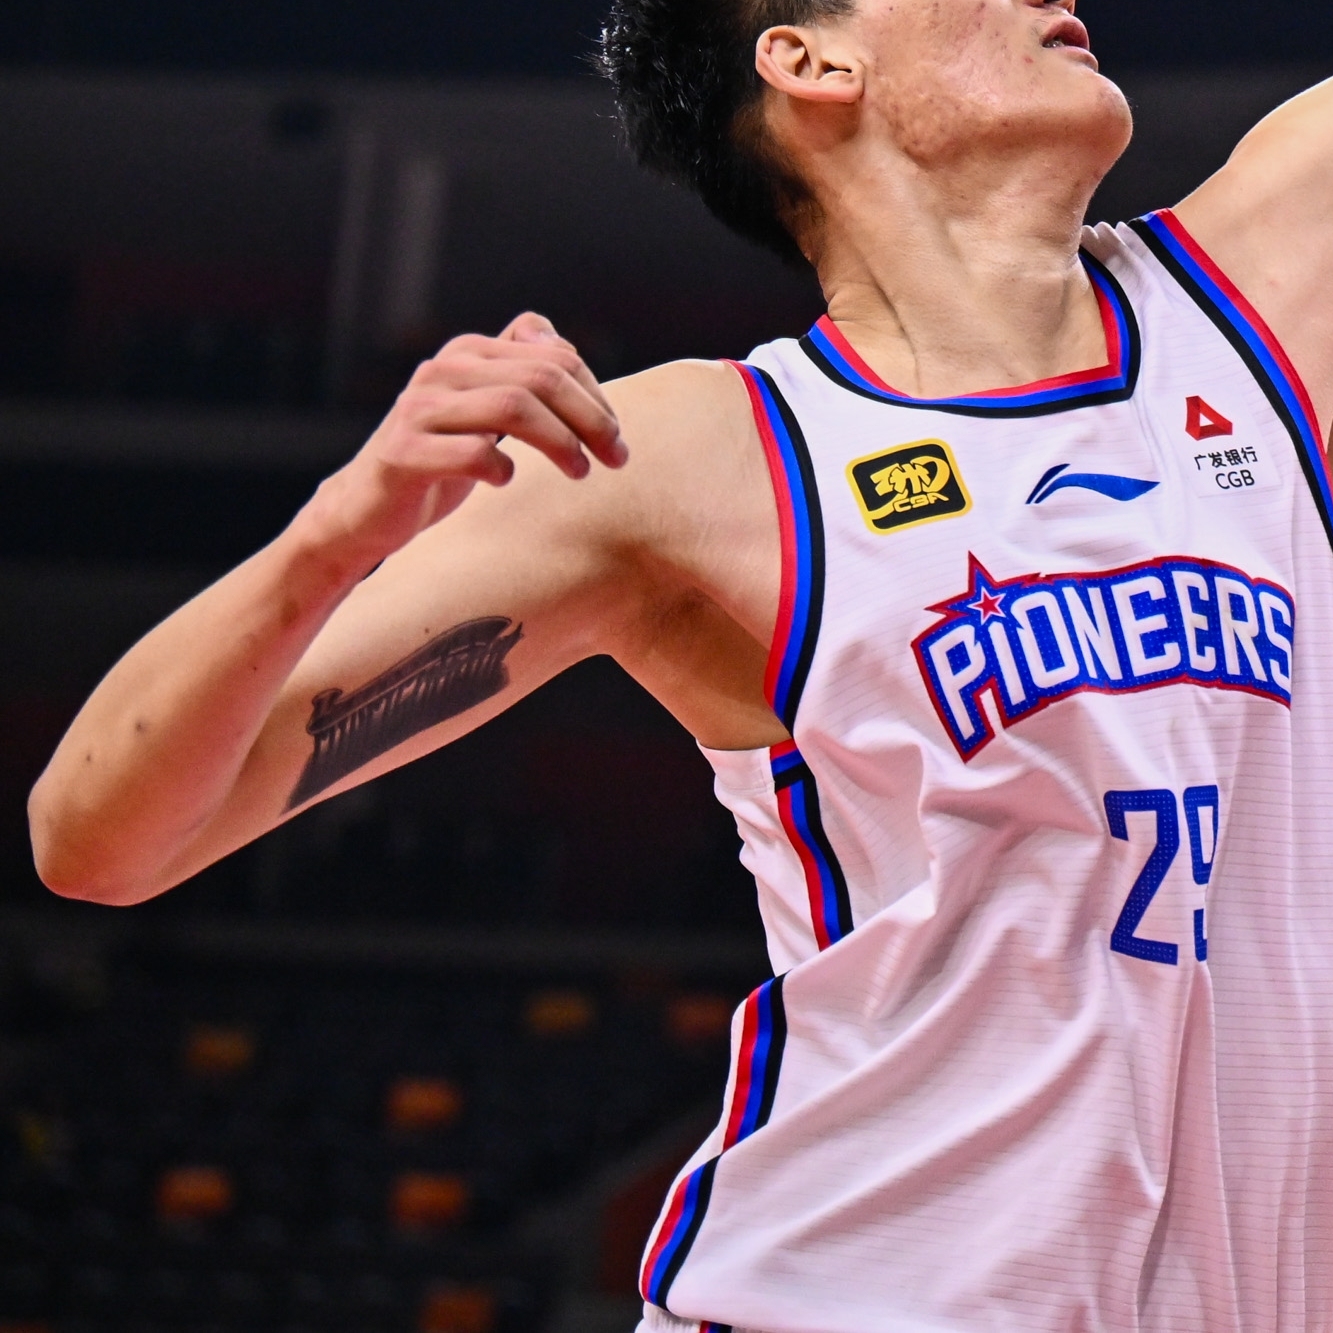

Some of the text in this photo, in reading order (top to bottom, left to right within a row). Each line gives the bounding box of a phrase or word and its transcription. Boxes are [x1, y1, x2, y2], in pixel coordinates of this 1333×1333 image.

[1194, 446, 1258, 470] 广发银行
[1215, 469, 1255, 490] CGB
[892, 492, 950, 513] CBA
[920, 562, 1295, 751] PIONEERS
